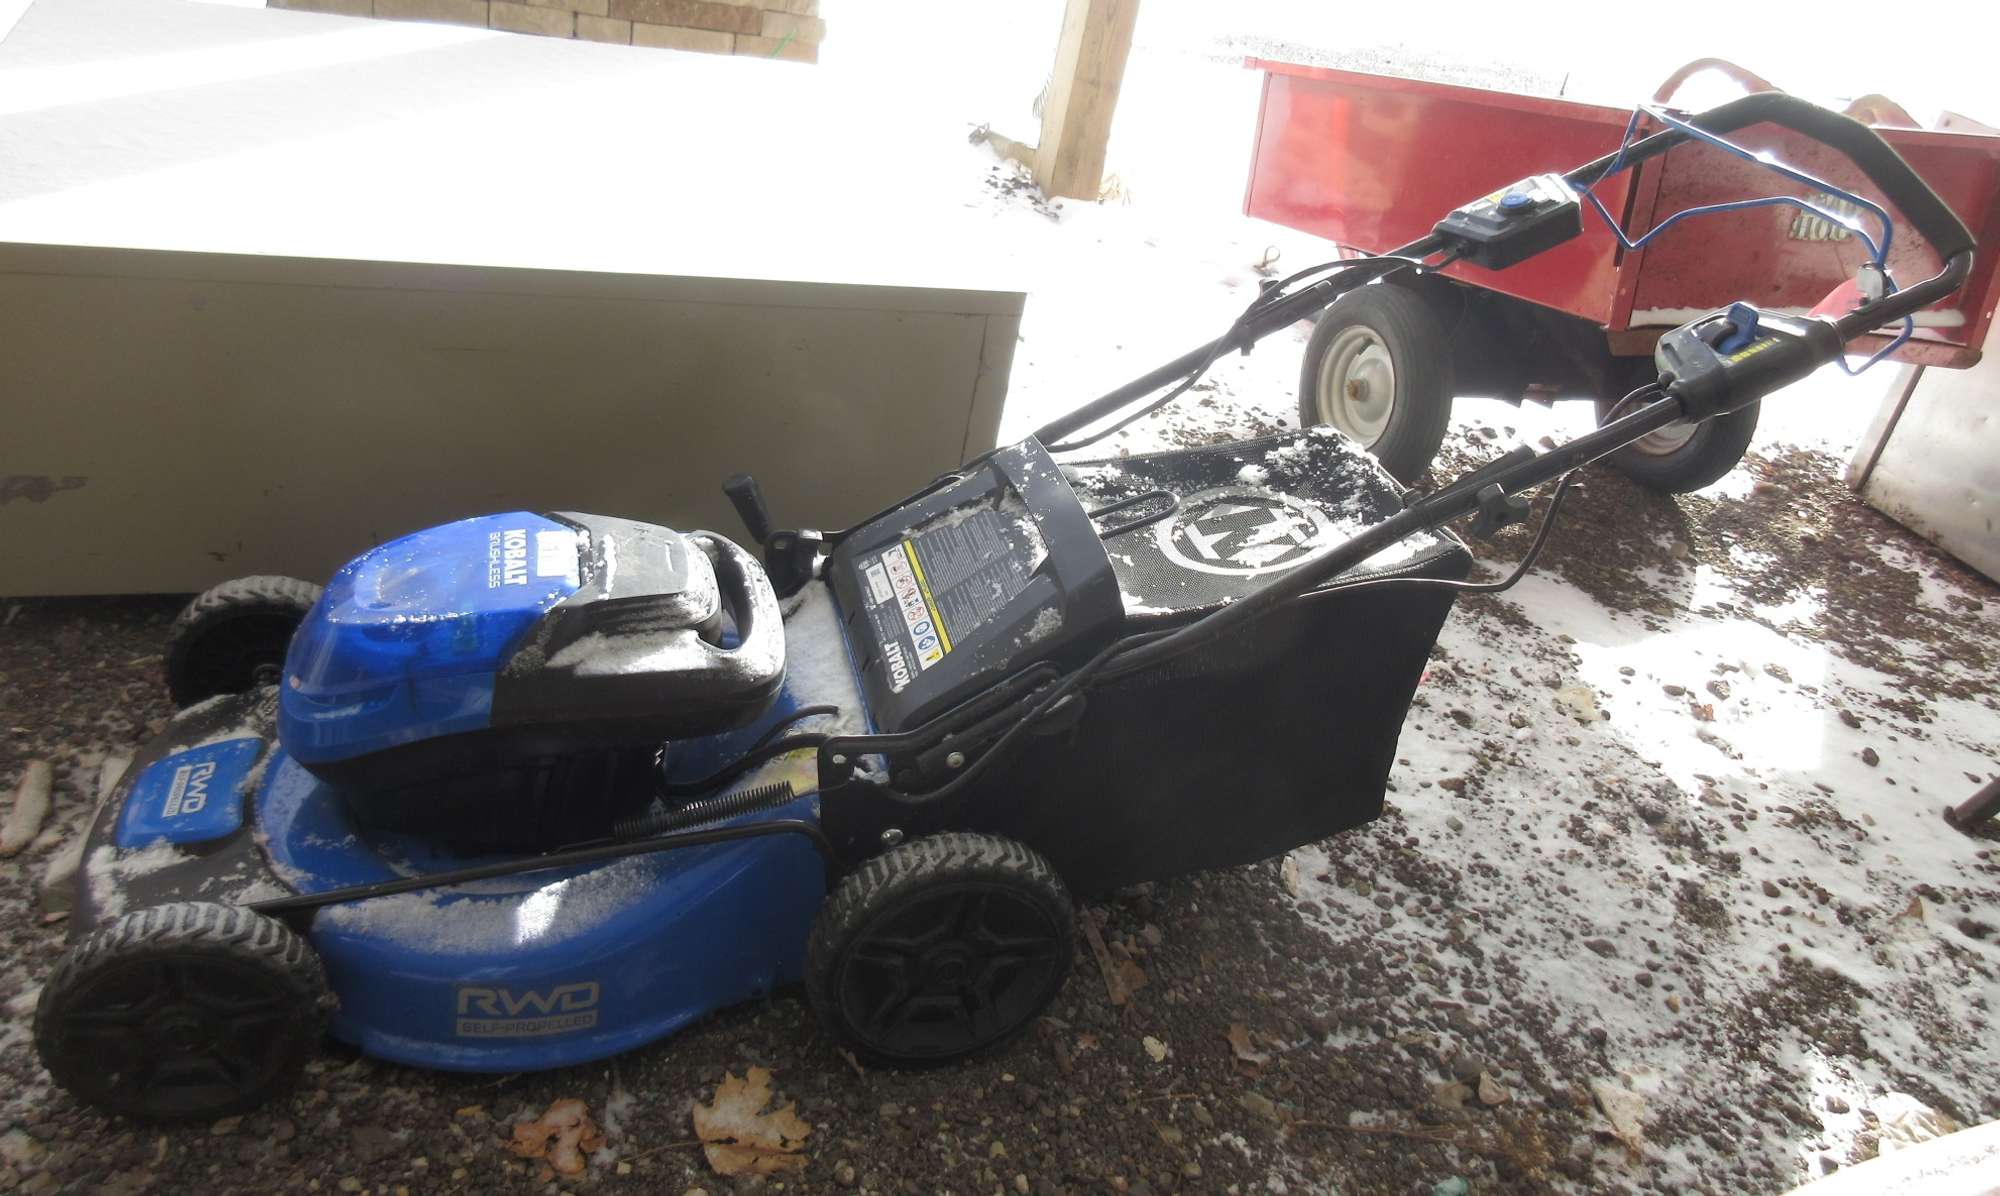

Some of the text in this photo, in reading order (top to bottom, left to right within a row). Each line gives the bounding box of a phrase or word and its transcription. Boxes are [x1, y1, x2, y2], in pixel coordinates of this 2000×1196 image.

[489, 531, 501, 589] BRUSHLESS
[504, 529, 527, 585] KOBALT
[884, 641, 911, 688] KOBALT
[181, 761, 216, 814] RWD
[457, 981, 600, 1015] RWD
[461, 1014, 593, 1034] SELF-PROPELLED
